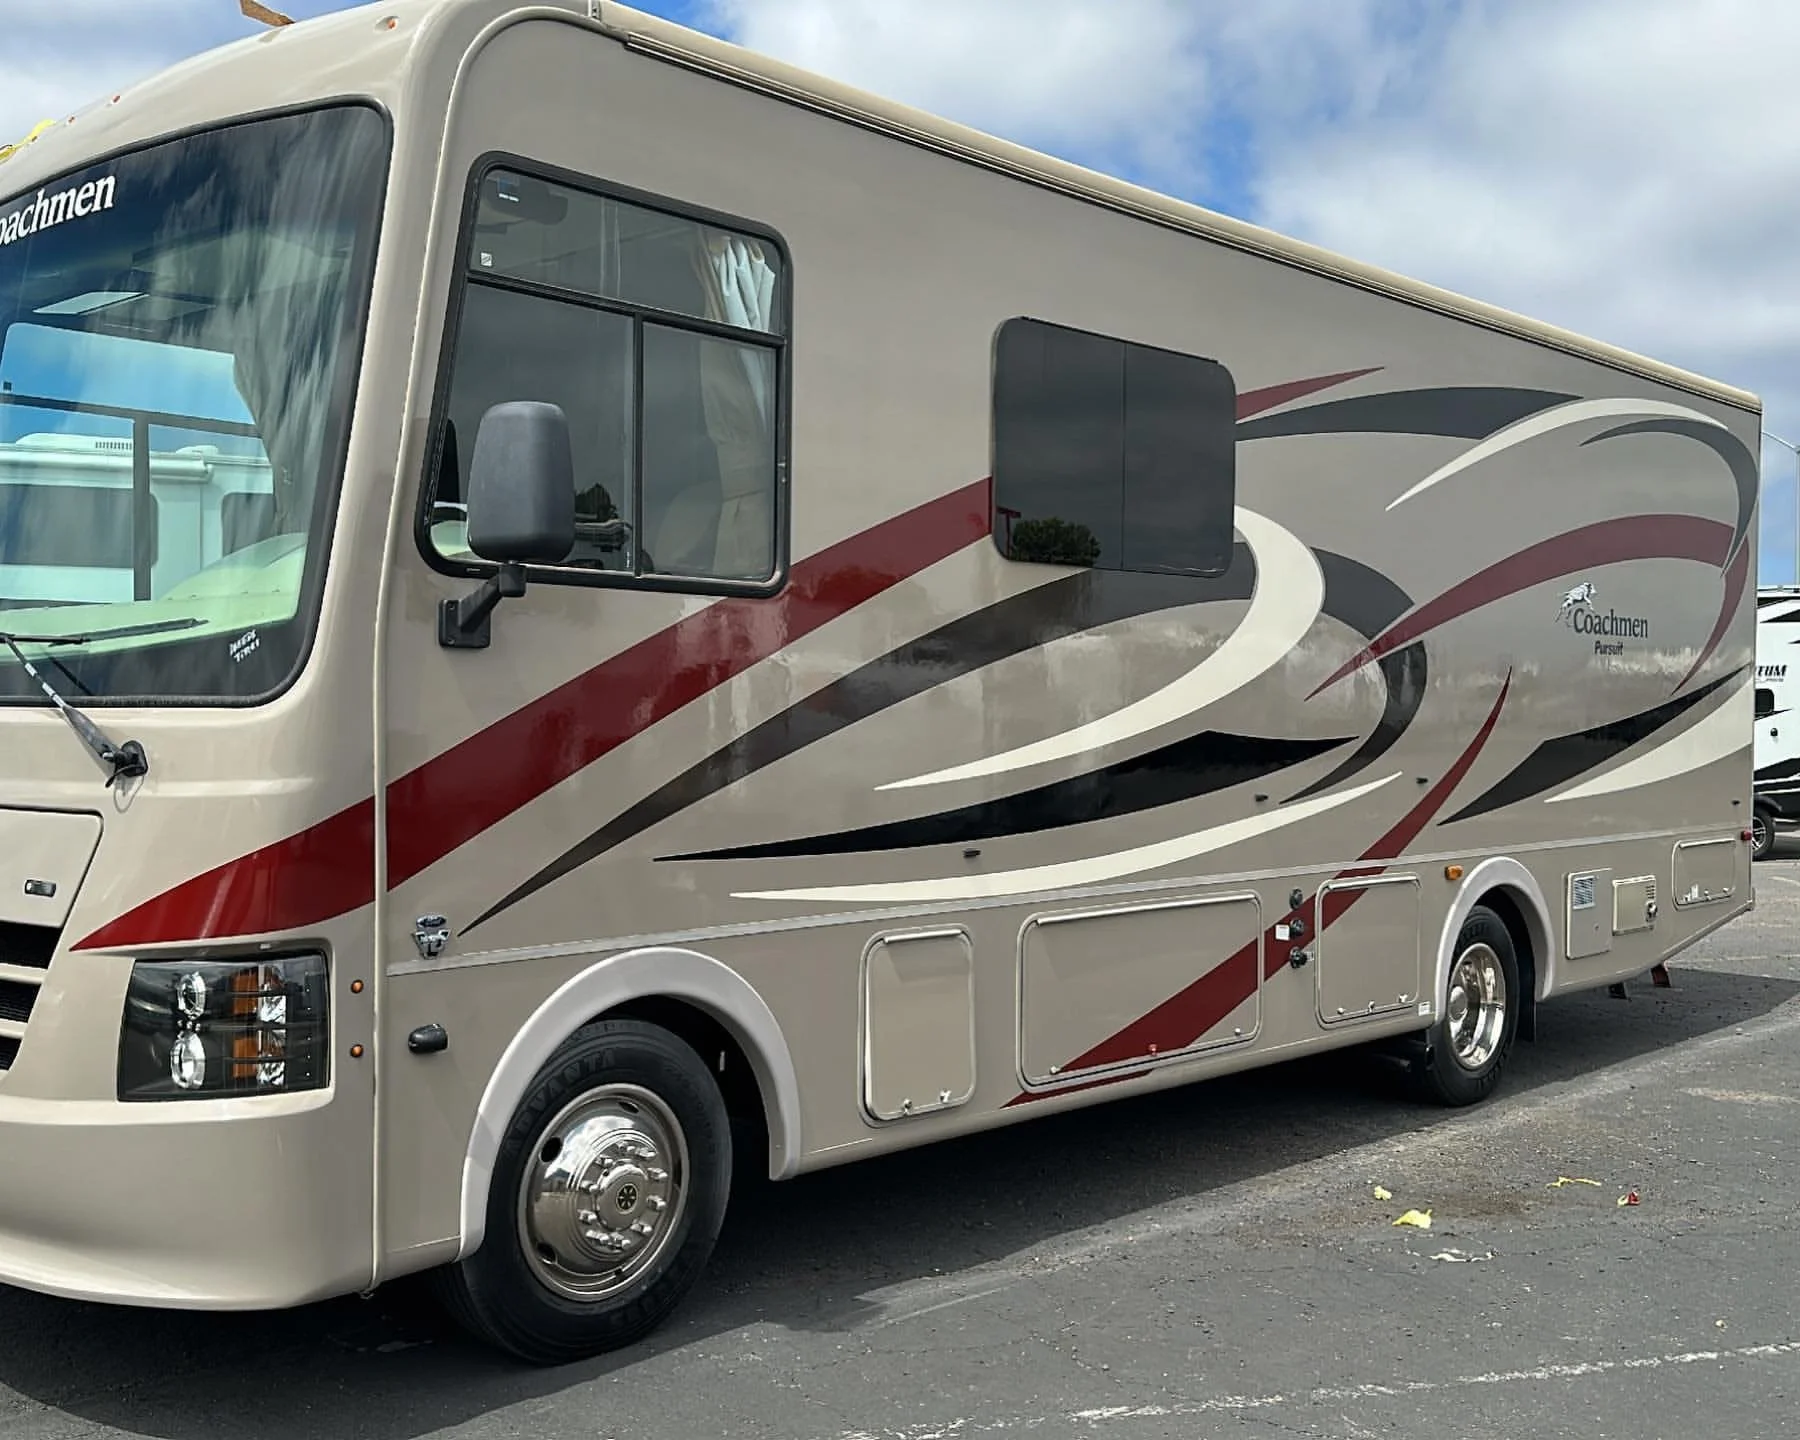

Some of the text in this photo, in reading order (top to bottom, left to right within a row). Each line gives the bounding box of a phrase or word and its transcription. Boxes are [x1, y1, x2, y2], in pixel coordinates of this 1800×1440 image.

[1573, 607, 1648, 638] Coachmen
[1594, 639, 1624, 657] Pursuit
[1756, 664, 1788, 677] TUM
